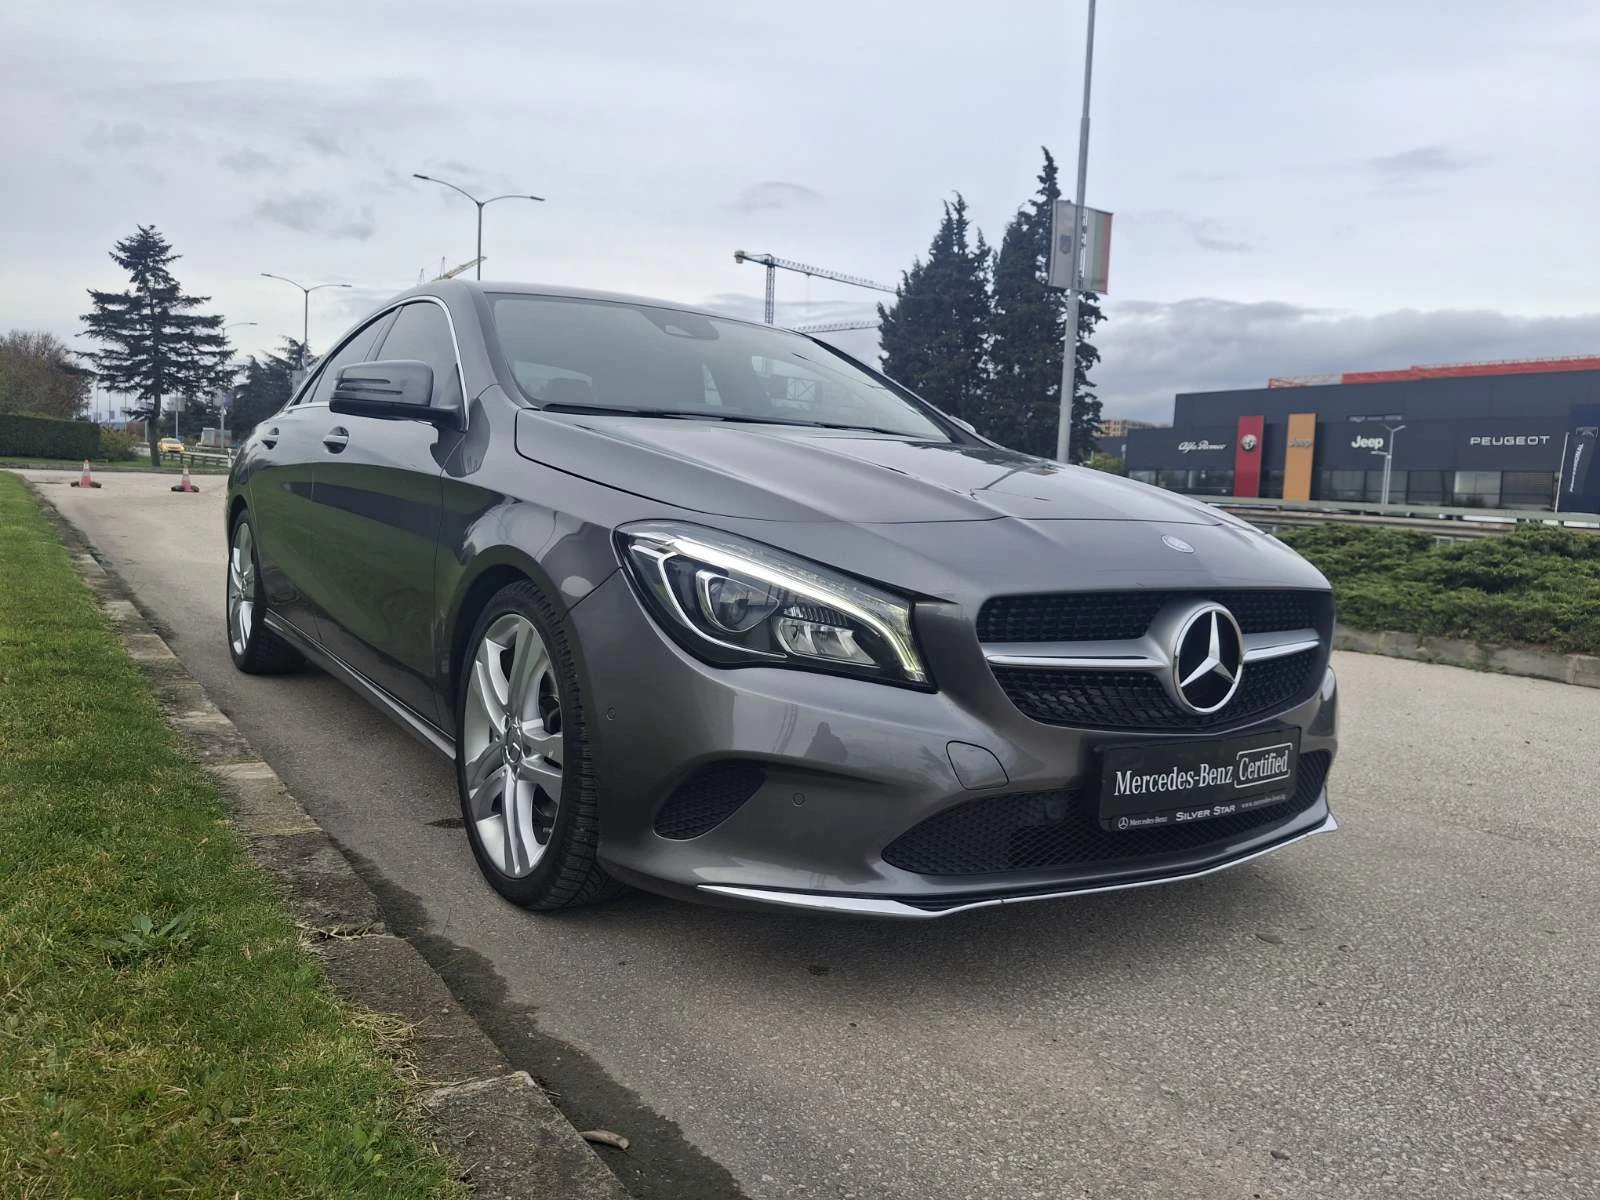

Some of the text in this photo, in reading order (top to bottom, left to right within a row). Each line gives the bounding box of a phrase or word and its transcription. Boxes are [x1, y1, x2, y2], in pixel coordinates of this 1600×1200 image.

[1351, 435, 1384, 450] Jeep
[1470, 435, 1550, 446] PEUGEOT
[1113, 750, 1289, 796] Mercedes-Benz Certified
[1175, 810, 1211, 821] SILVER
[1213, 805, 1236, 816] STAR
